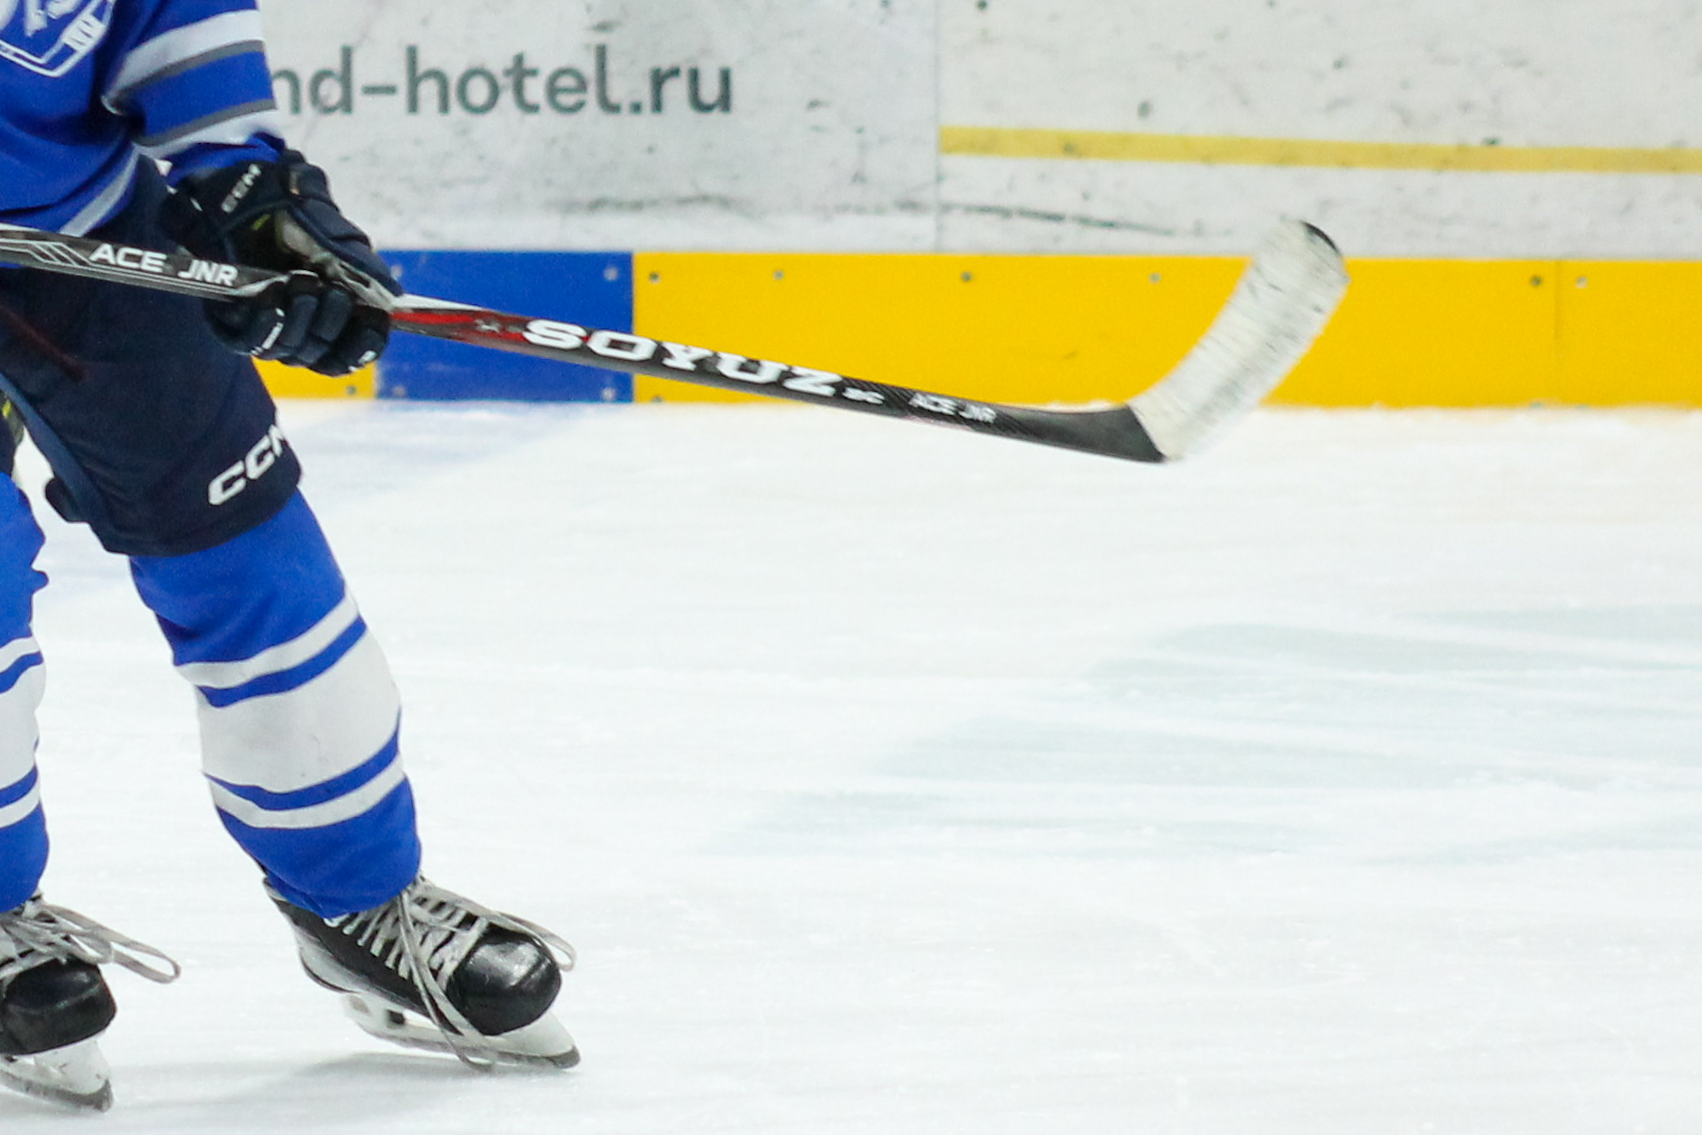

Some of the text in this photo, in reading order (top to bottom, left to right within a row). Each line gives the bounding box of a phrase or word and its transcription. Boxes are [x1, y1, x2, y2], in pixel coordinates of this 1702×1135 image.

[89, 241, 239, 287] ACE JNR
[522, 319, 843, 397] SOYUZ
